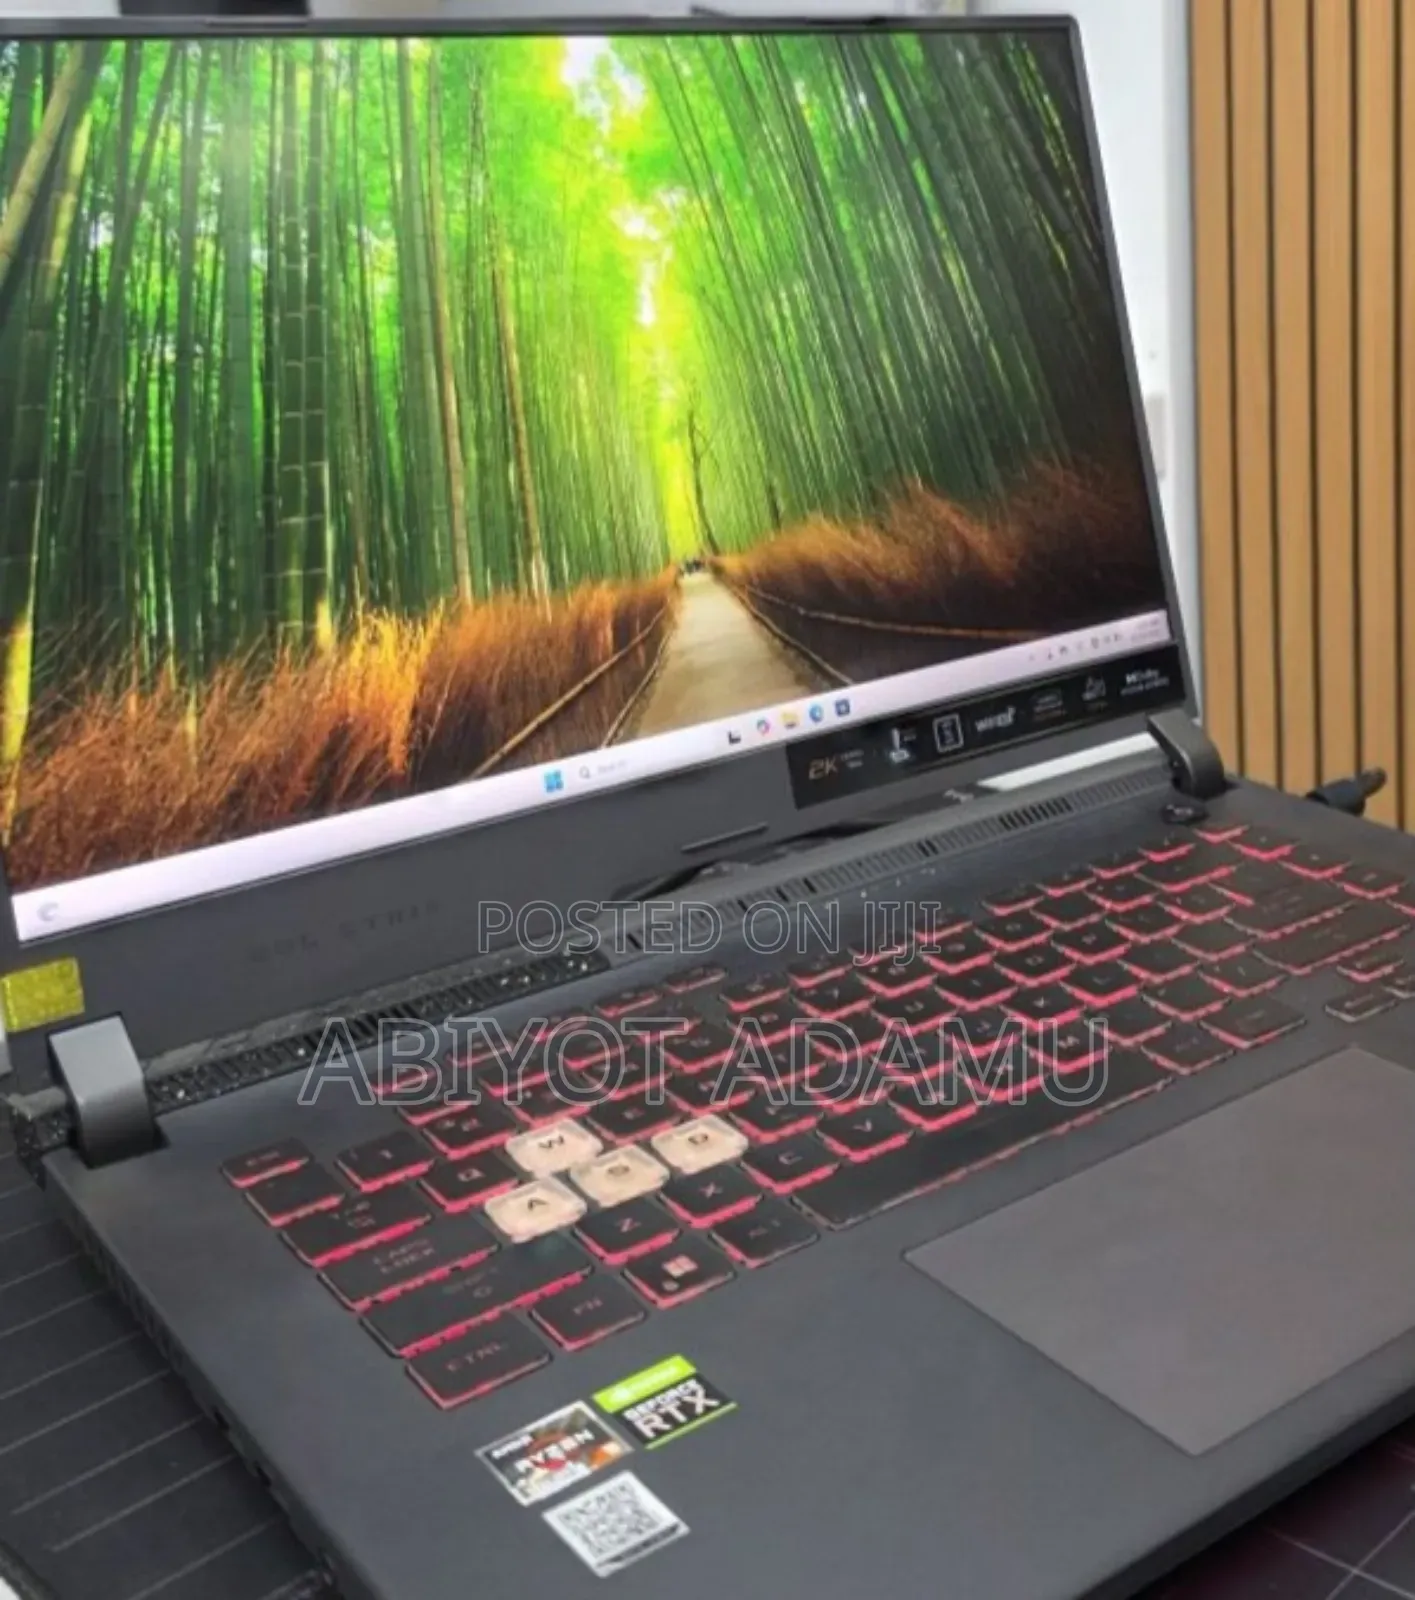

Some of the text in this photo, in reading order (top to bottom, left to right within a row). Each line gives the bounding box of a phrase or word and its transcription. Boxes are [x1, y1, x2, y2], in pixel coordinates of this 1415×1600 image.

[538, 1134, 566, 1150] W
[703, 1181, 724, 1198] X
[527, 1197, 549, 1211] A
[619, 1217, 643, 1233] Z
[634, 1384, 720, 1439] RTX
[514, 1429, 596, 1473] RYZEN
